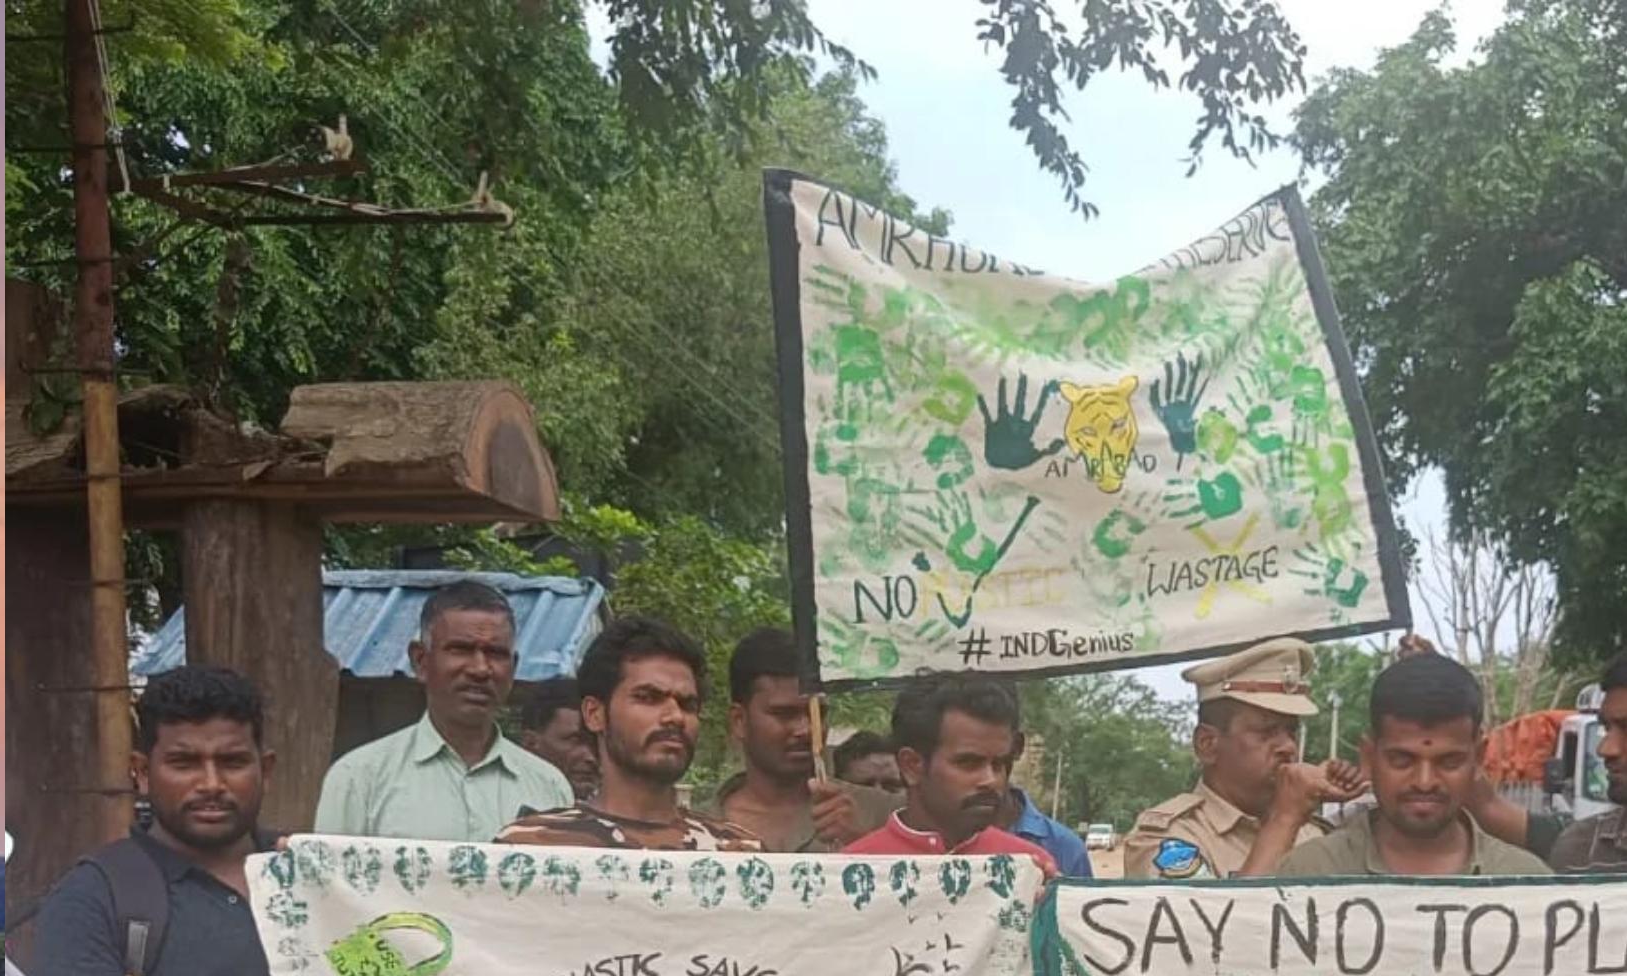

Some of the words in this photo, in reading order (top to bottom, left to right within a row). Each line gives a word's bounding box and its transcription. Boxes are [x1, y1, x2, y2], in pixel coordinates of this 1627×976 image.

[853, 574, 918, 624] NO
[1144, 546, 1280, 598] WASTAGE
[375, 939, 401, 970] USE
[1080, 896, 1236, 976] SAY
[1269, 896, 1386, 976] NO
